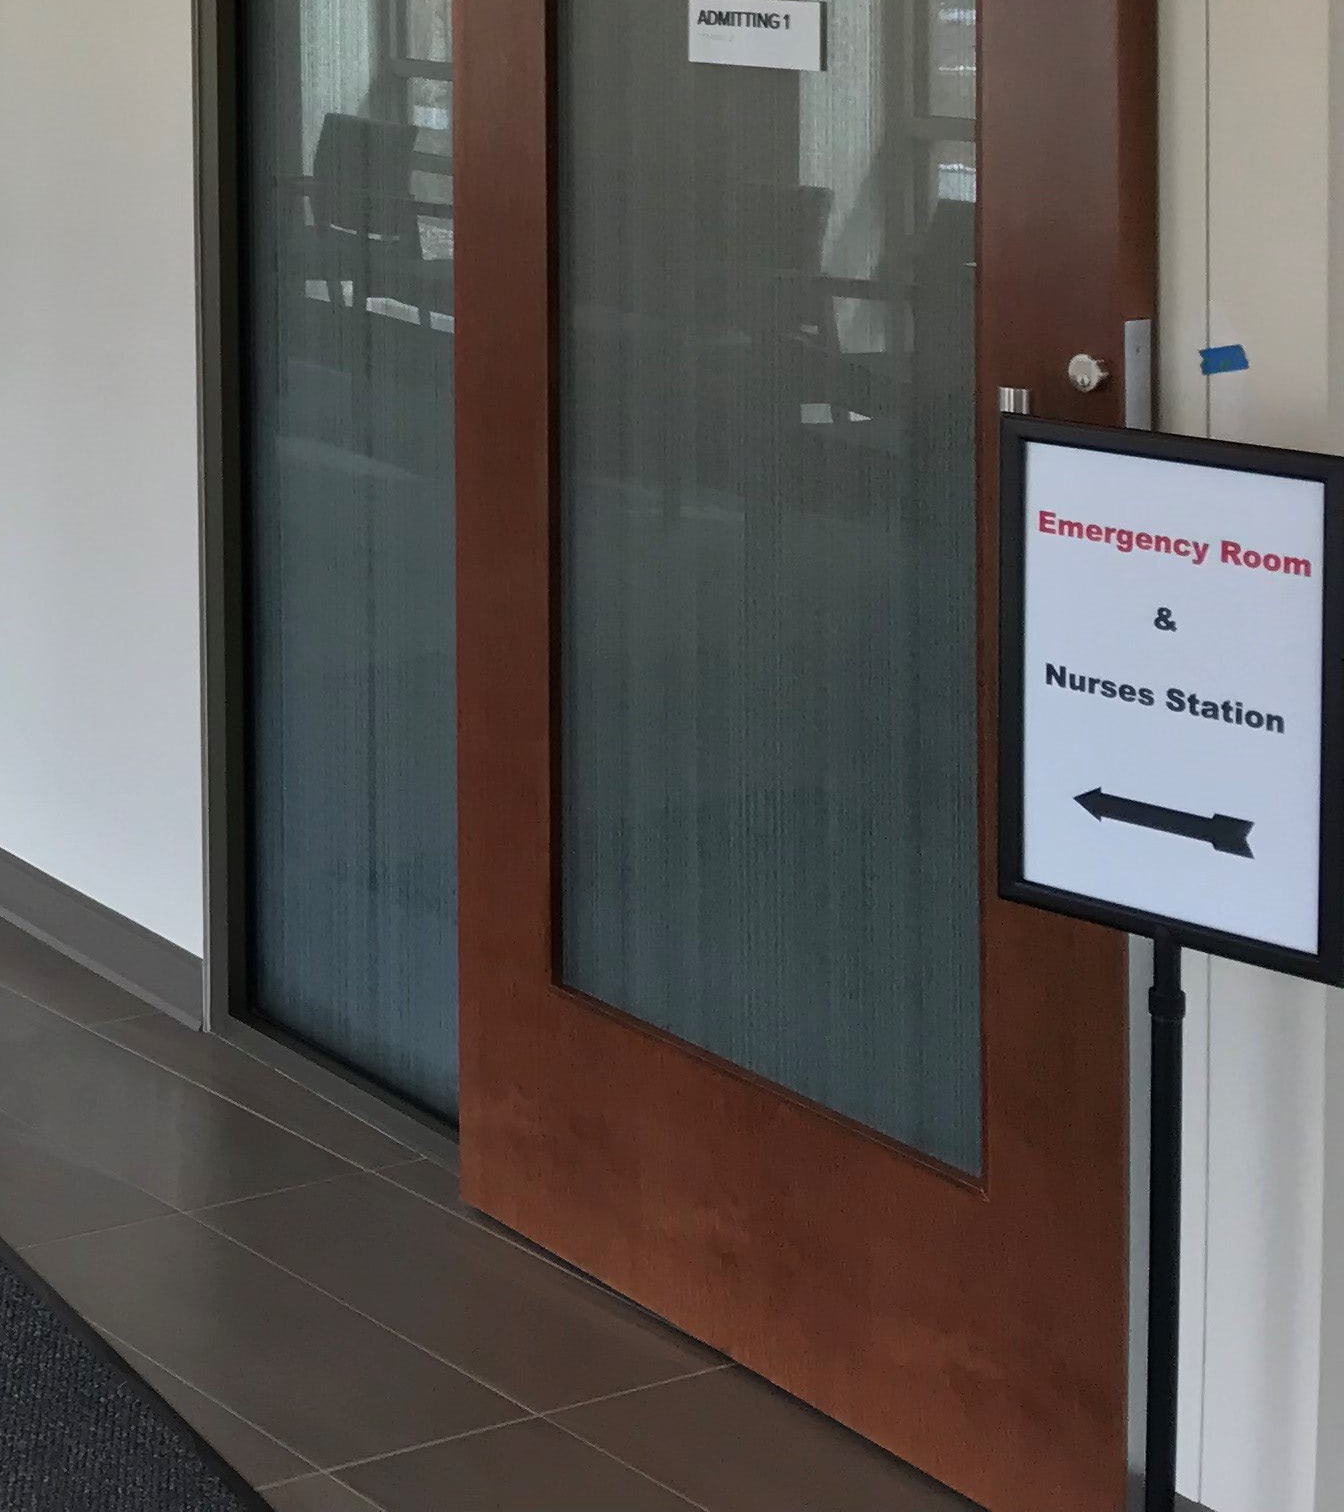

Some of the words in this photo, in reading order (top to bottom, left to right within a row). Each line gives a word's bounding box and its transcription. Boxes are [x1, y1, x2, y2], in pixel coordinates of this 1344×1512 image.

[697, 9, 781, 30] ADMITTING
[782, 13, 791, 30] 1
[1038, 510, 1209, 565] Emergency
[1221, 540, 1313, 578] Room
[1154, 607, 1177, 633] &
[1045, 663, 1155, 707] Nurses
[1165, 689, 1286, 735] Station
